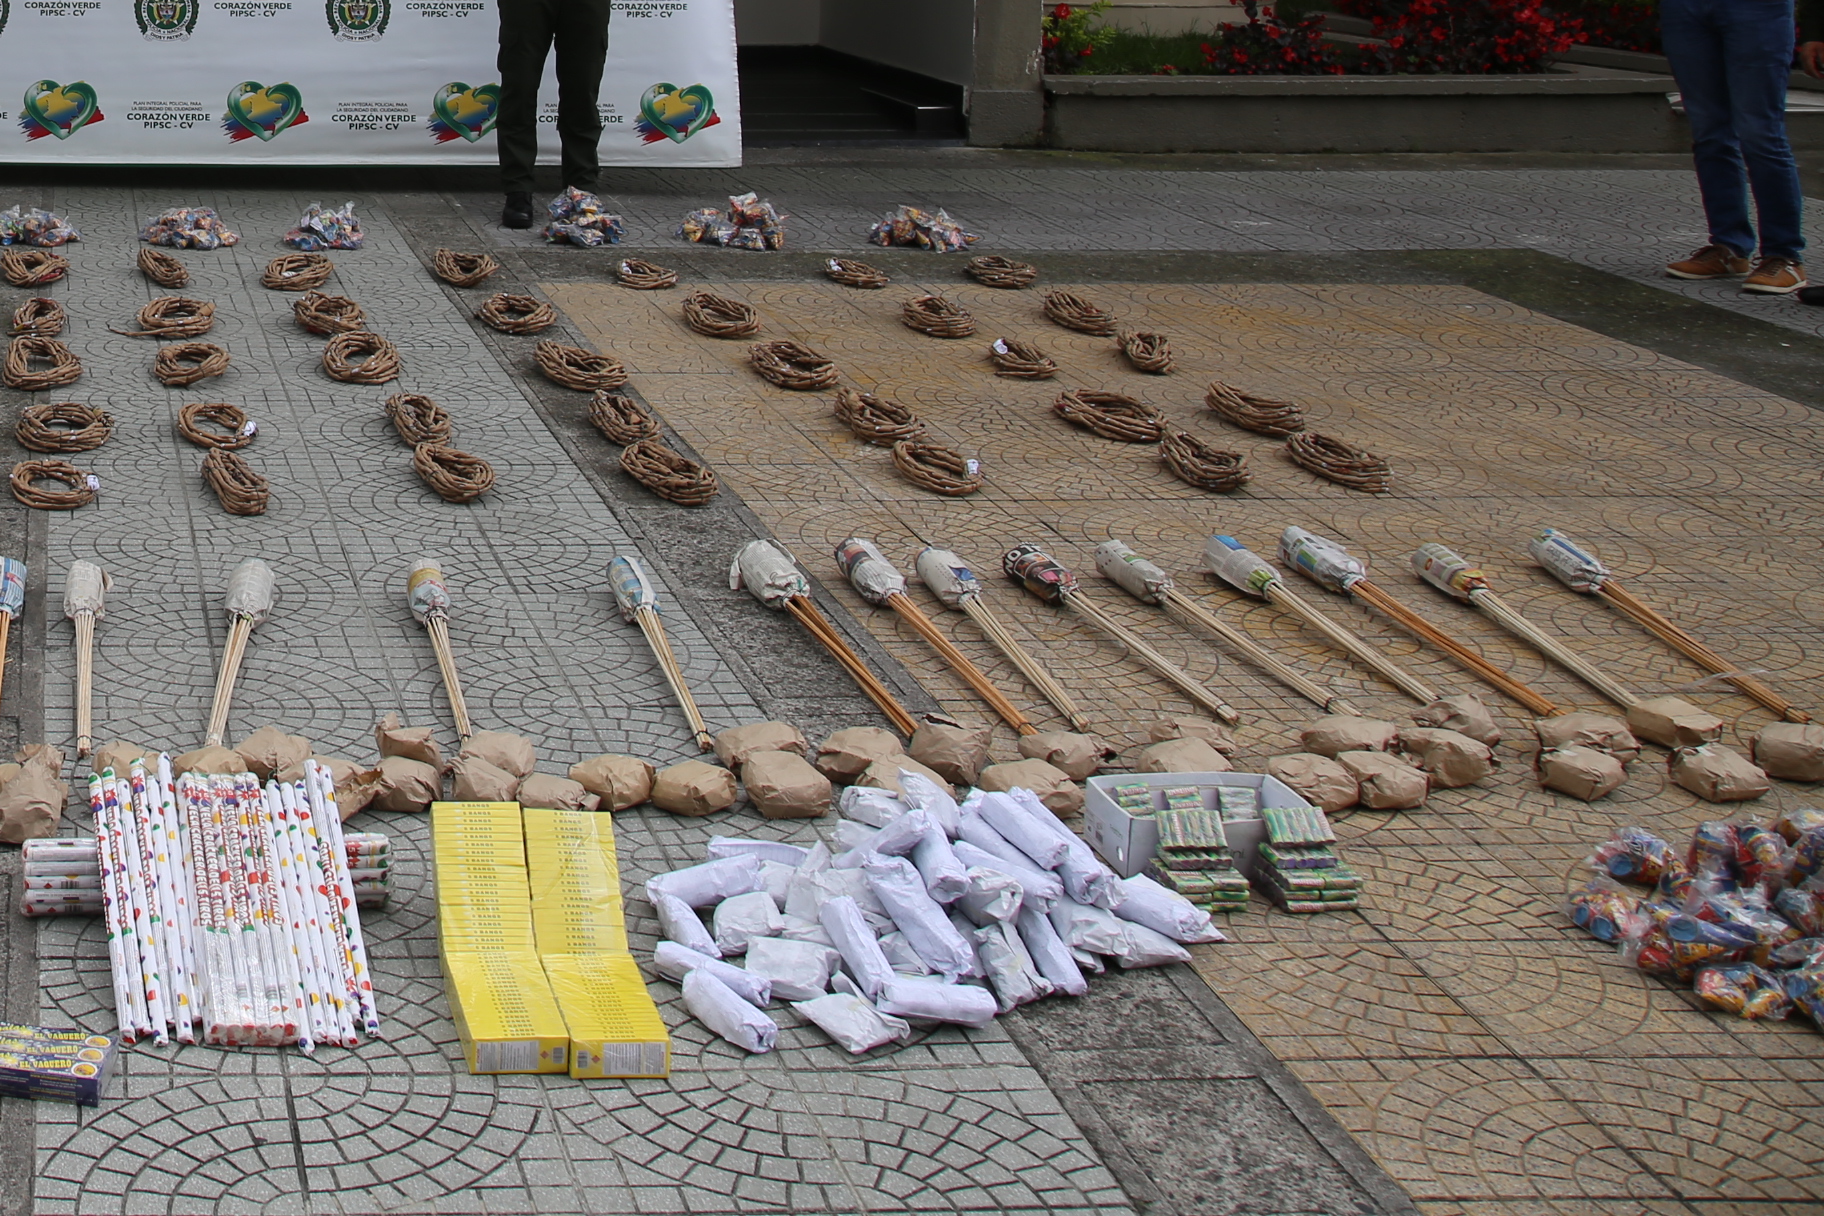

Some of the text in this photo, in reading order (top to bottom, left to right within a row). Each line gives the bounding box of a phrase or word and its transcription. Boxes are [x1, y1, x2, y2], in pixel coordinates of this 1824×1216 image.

[213, 1, 292, 10] CORAZÓN VERDE
[229, 10, 256, 18] PIPSC
[263, 10, 277, 18] CV
[47, 1032, 86, 1041] VAQUERO
[39, 1046, 79, 1055] VAQUERO
[19, 1059, 72, 1069] EL VAQUERO
